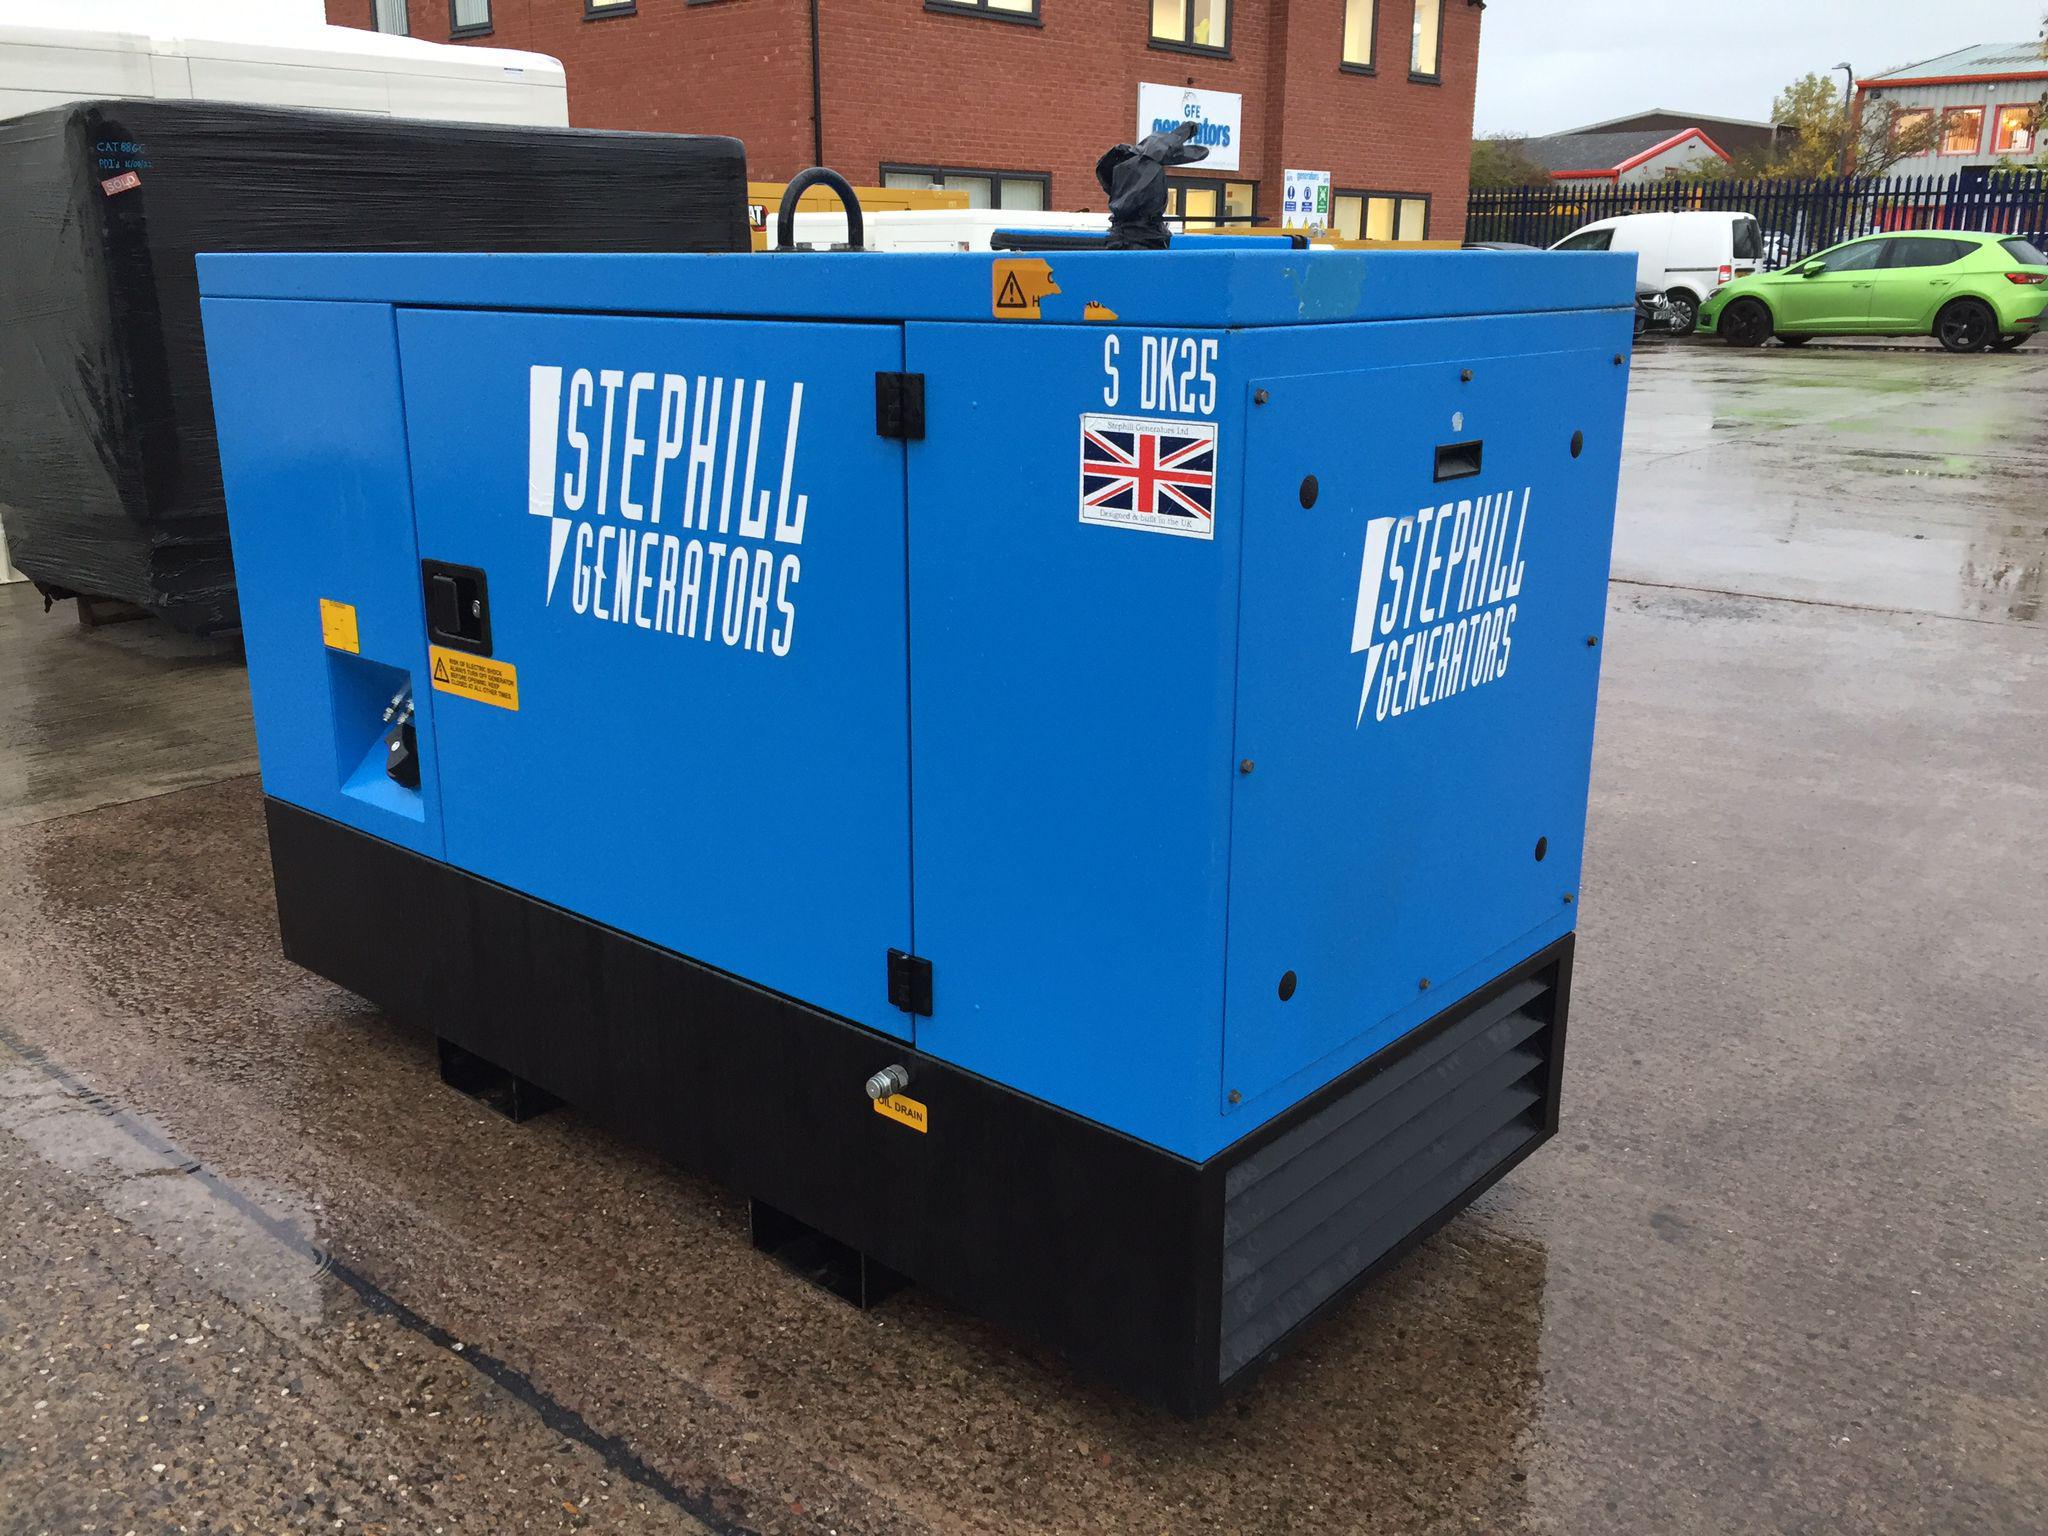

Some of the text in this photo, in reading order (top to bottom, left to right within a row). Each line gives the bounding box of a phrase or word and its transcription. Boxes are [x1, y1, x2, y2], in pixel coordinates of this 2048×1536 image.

[1184, 104, 1201, 118] GFE
[96, 141, 119, 152] CAT
[748, 205, 763, 226] AT
[1103, 333, 1219, 415] S DK25
[1107, 421, 1189, 436] Stephill Generators Ltd
[563, 367, 808, 545] STEPHILL
[1100, 508, 1131, 520] Designed
[1140, 513, 1157, 523] built
[1158, 516, 1166, 525] in
[1167, 517, 1179, 526] the
[1181, 519, 1192, 528] UK
[1379, 486, 1531, 636] STEPHILL
[571, 521, 801, 658] GENERATORS
[466, 661, 486, 672] ELECTRIC
[487, 667, 502, 676] SHOCK
[1375, 603, 1517, 723] GENERATORS
[488, 674, 514, 686] GENERATOR
[877, 1097, 923, 1122] OIL DRAIN
